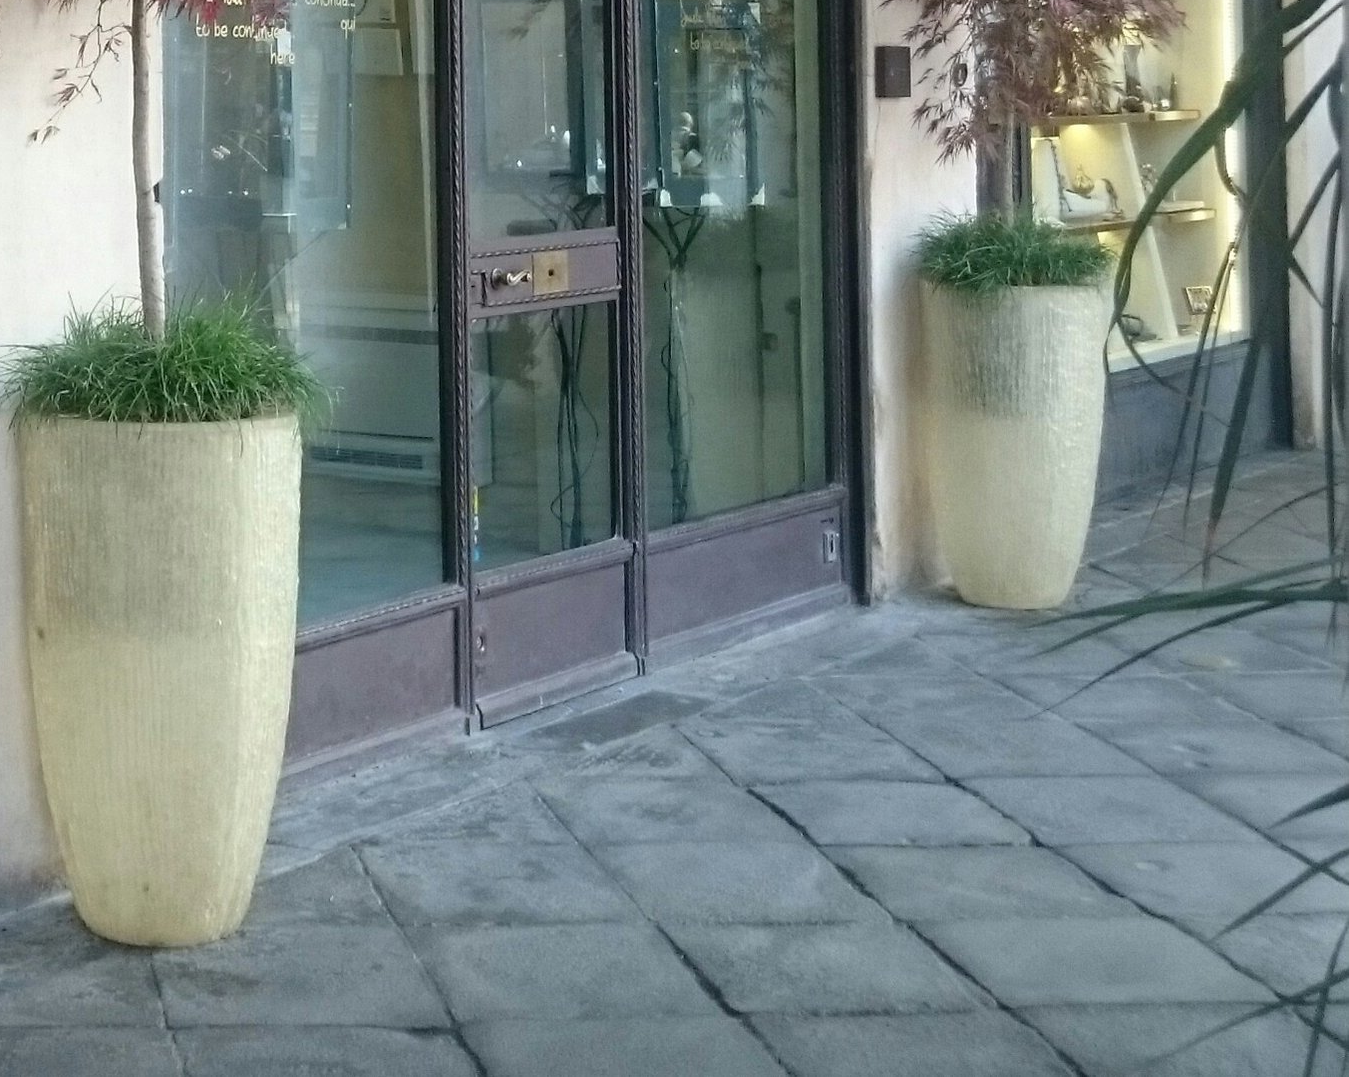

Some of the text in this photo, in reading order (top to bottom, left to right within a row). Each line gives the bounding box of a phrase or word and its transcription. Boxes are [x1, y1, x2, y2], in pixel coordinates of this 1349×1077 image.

[213, 19, 228, 38] be
[340, 14, 356, 40] qui
[270, 43, 295, 65] here
